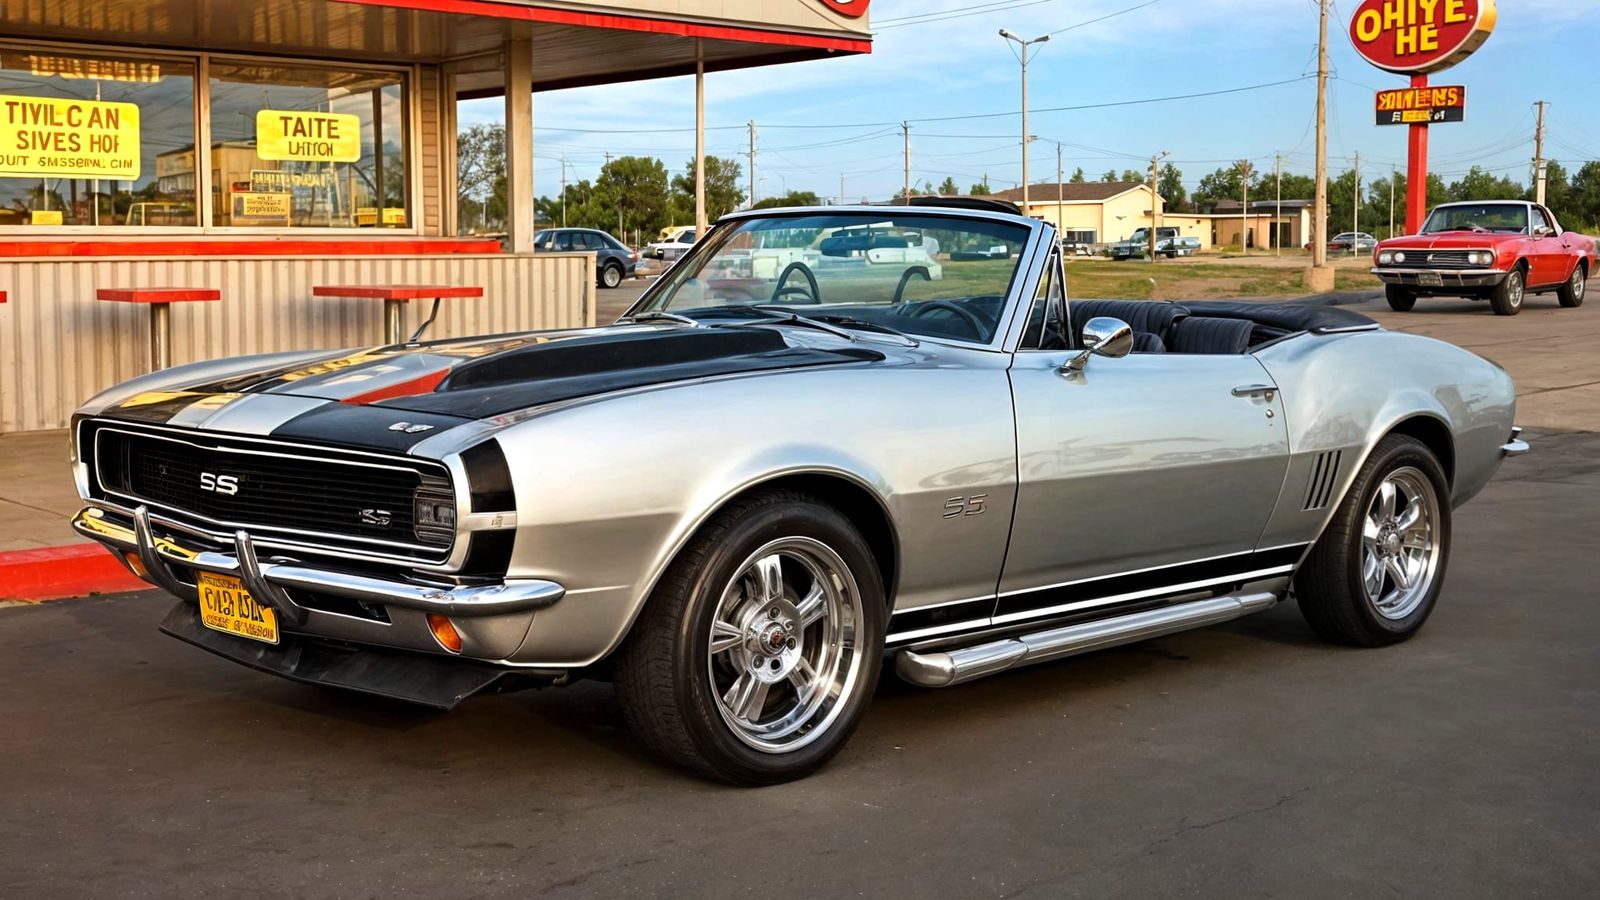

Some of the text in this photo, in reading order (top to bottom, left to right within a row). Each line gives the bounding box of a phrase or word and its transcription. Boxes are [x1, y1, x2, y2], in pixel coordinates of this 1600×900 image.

[1396, 24, 1439, 55] HE
[279, 116, 340, 139] TAITE
[16, 130, 81, 153] SIVES
[201, 472, 239, 495] SS
